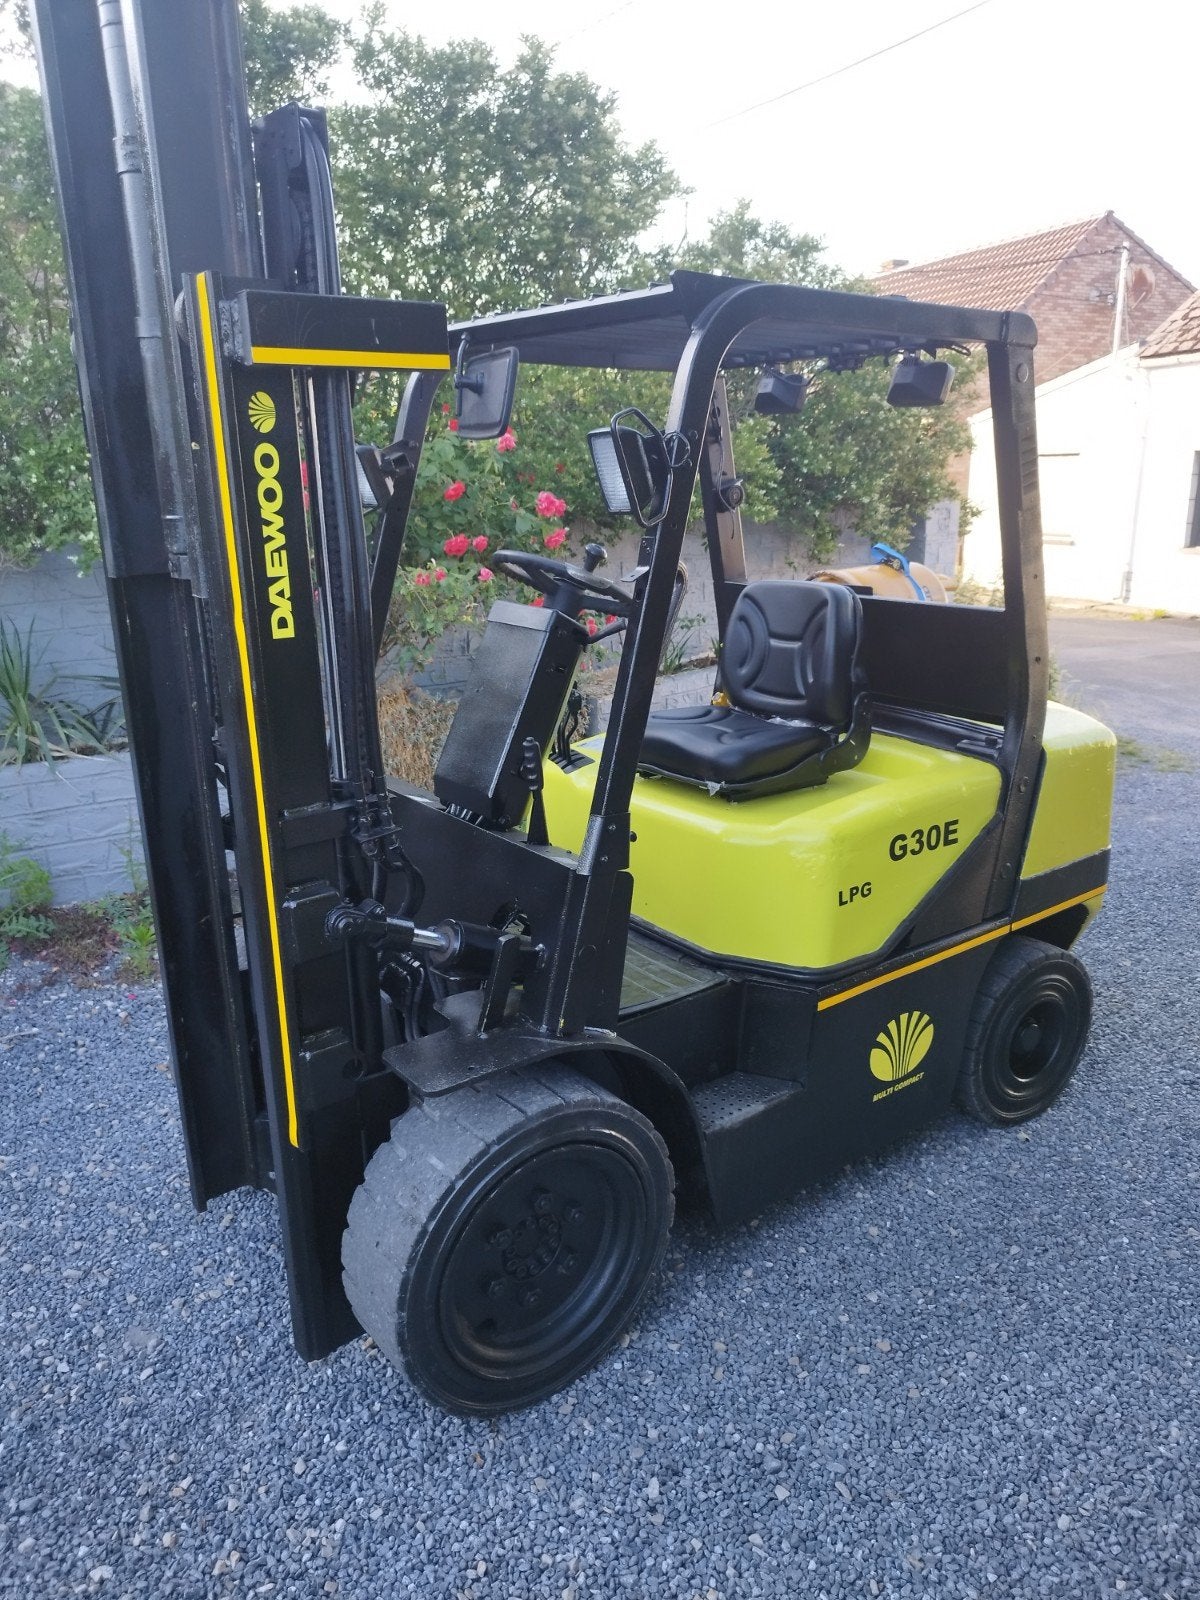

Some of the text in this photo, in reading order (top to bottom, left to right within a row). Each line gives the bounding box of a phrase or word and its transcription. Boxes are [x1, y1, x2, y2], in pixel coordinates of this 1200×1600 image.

[253, 442, 296, 640] DAEWOO
[889, 819, 960, 862] G30E
[838, 881, 872, 907] LPG
[872, 1071, 925, 1103] MULTI COMPACT
